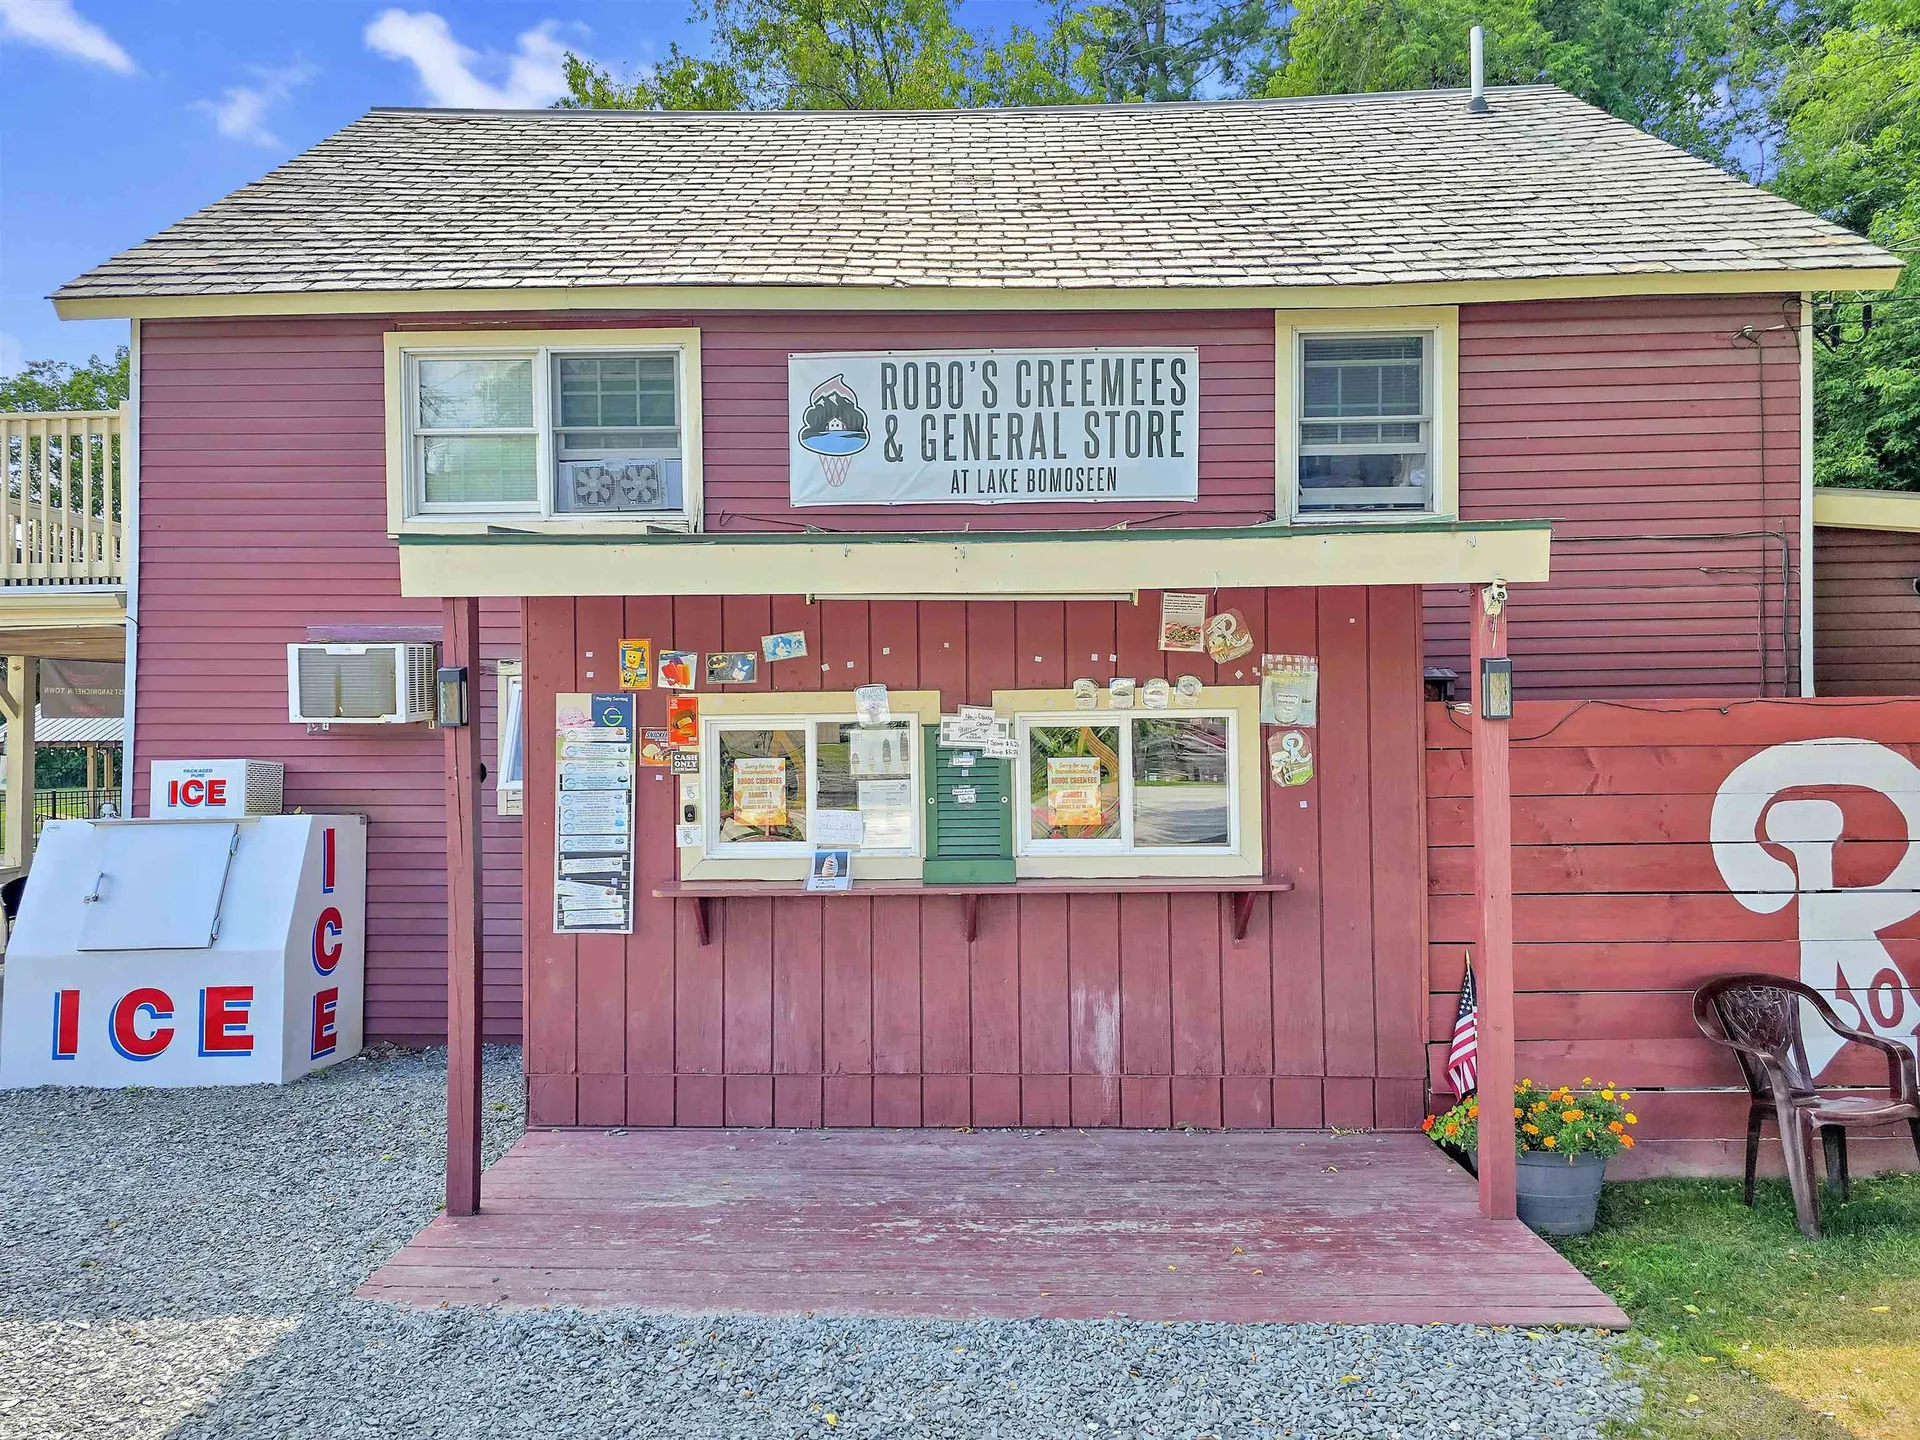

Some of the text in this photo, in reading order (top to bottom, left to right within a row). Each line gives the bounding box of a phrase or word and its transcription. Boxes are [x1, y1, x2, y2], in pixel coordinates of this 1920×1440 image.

[880, 357, 1188, 411] ROBO'S CREEMEES
[883, 410, 1185, 463] & GENERAL STORE
[950, 466, 1118, 494] AT LAKE BOMOSEEN
[645, 731, 668, 739] SNICKE
[168, 779, 227, 807] ICE
[311, 828, 343, 1061] ICE
[51, 985, 255, 1062] ICE
